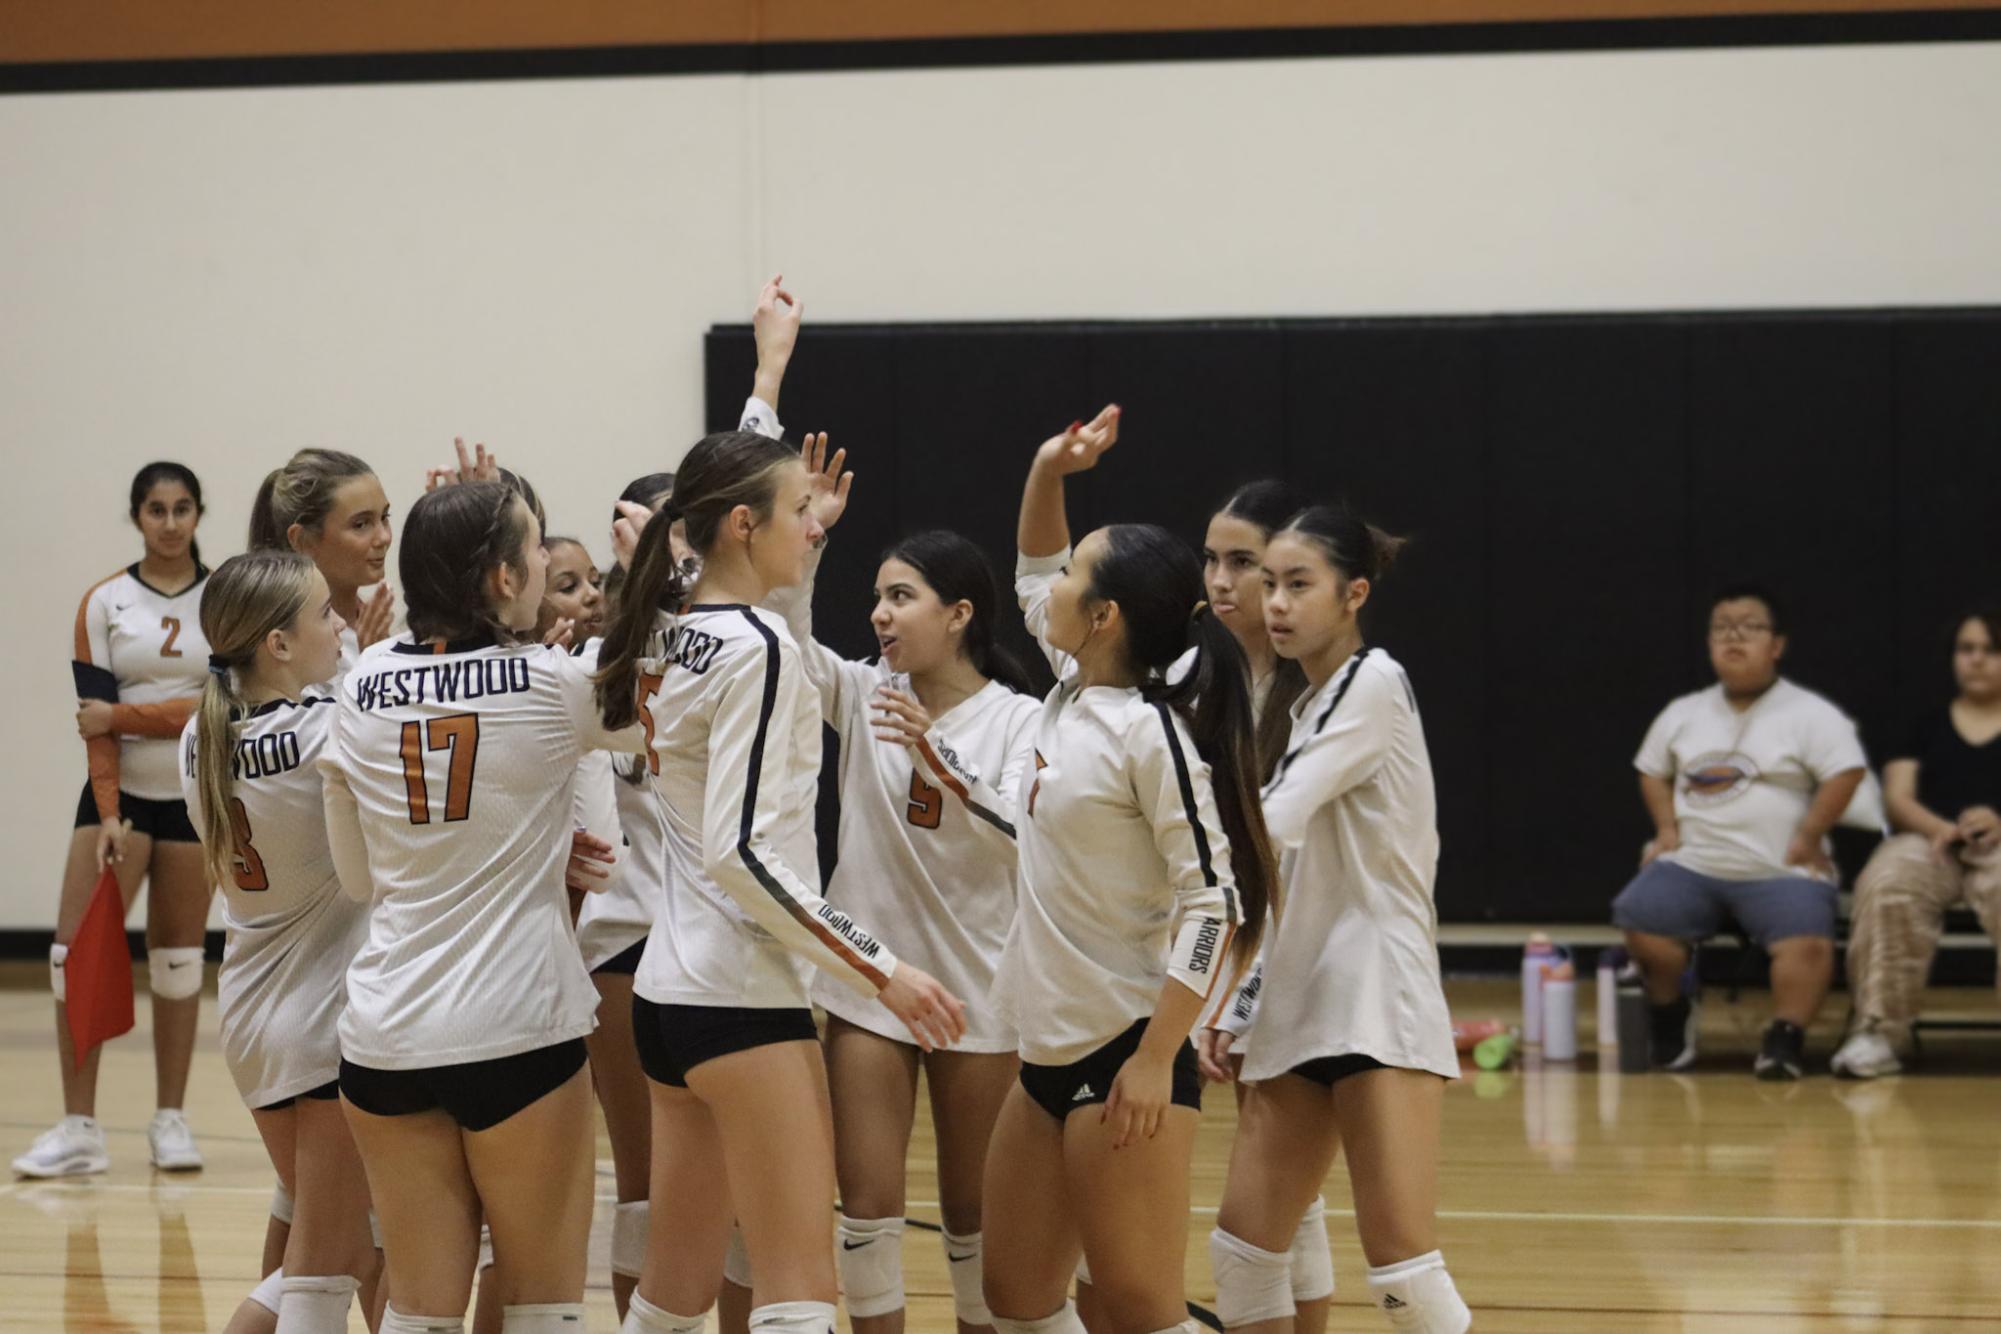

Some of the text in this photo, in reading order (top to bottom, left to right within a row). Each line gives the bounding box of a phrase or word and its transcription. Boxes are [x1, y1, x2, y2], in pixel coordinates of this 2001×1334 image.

[160, 616, 183, 657] 2
[357, 657, 530, 712] WESTWOOD
[400, 712, 480, 825] 17
[818, 904, 880, 959] WESTWOOD
[1188, 917, 1222, 974] ARRIORS
